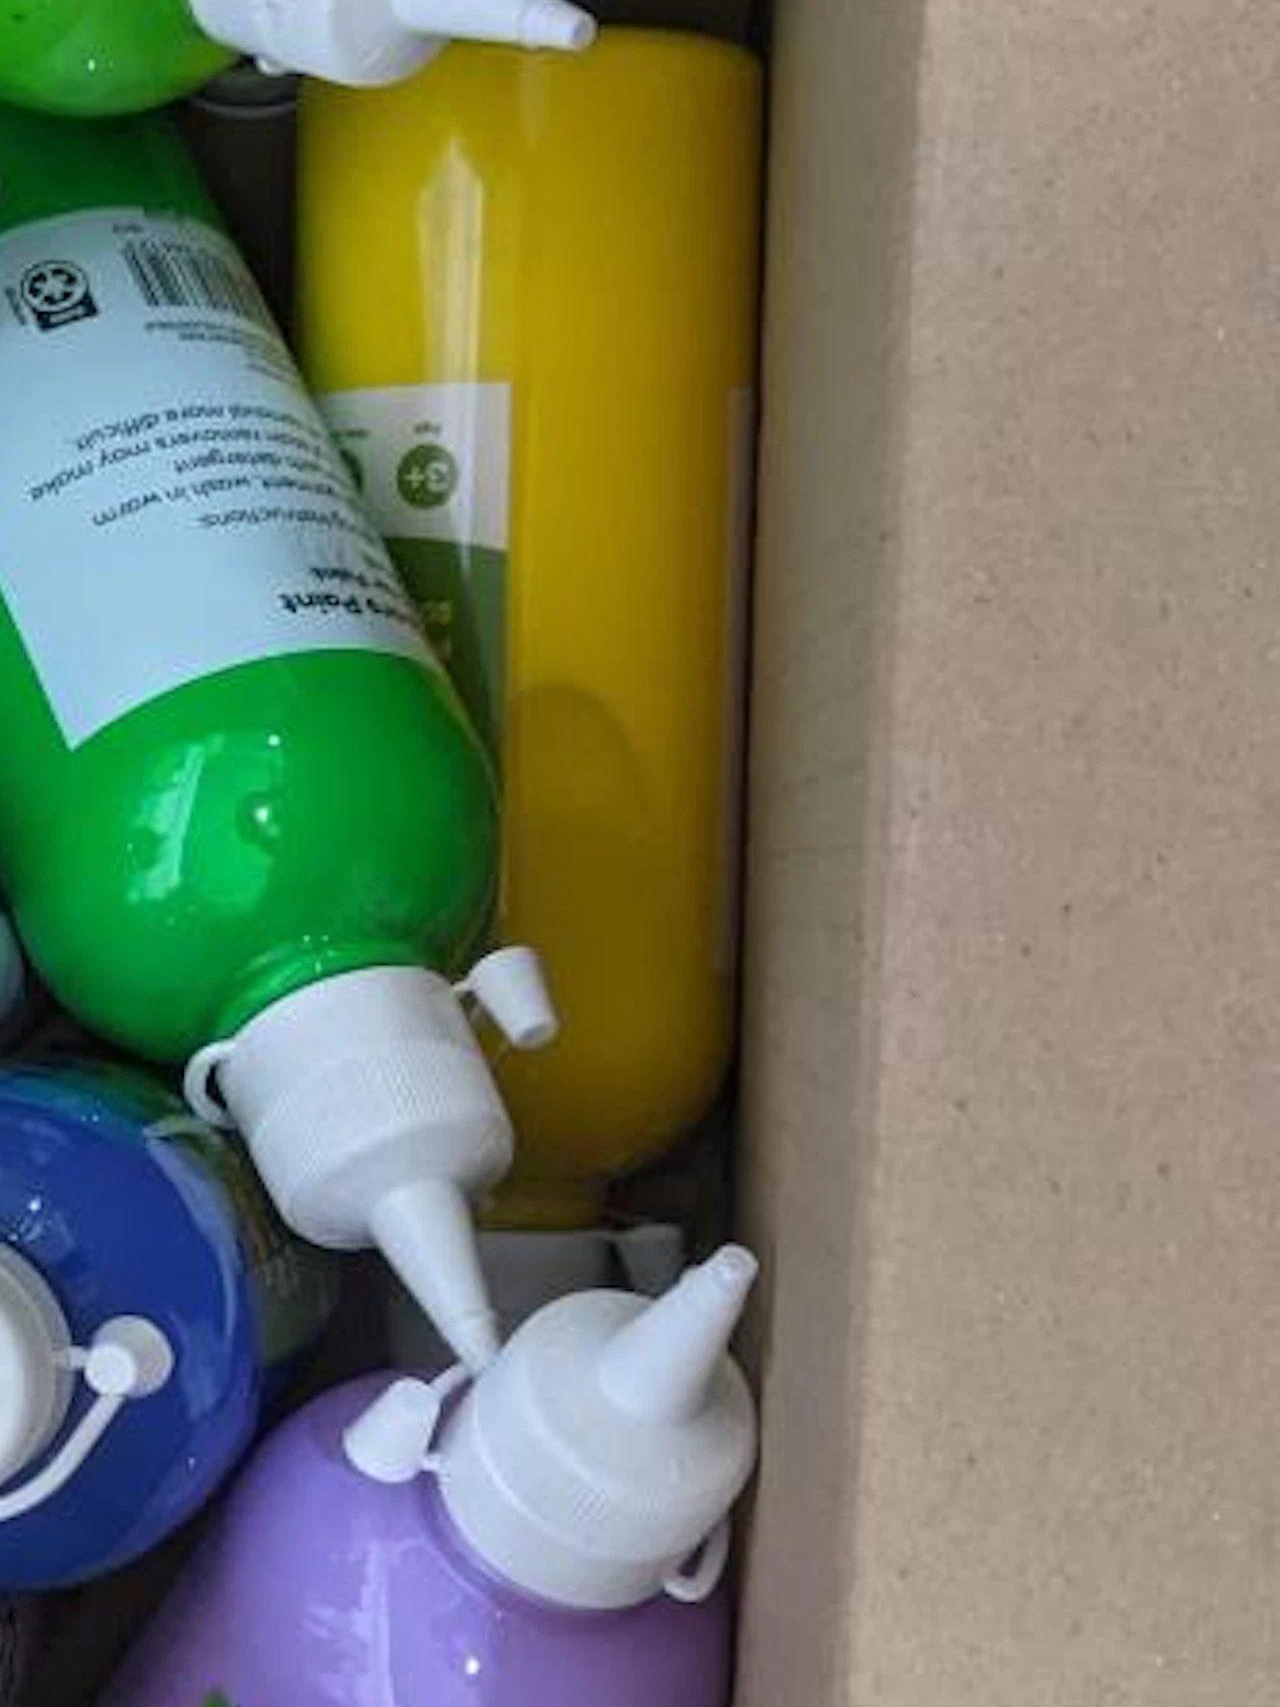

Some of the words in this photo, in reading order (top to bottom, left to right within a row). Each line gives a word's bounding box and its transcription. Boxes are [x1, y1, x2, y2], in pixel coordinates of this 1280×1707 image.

[100, 442, 152, 473] may
[27, 459, 95, 502] make
[403, 461, 450, 492] 3+
[91, 491, 164, 527] warm
